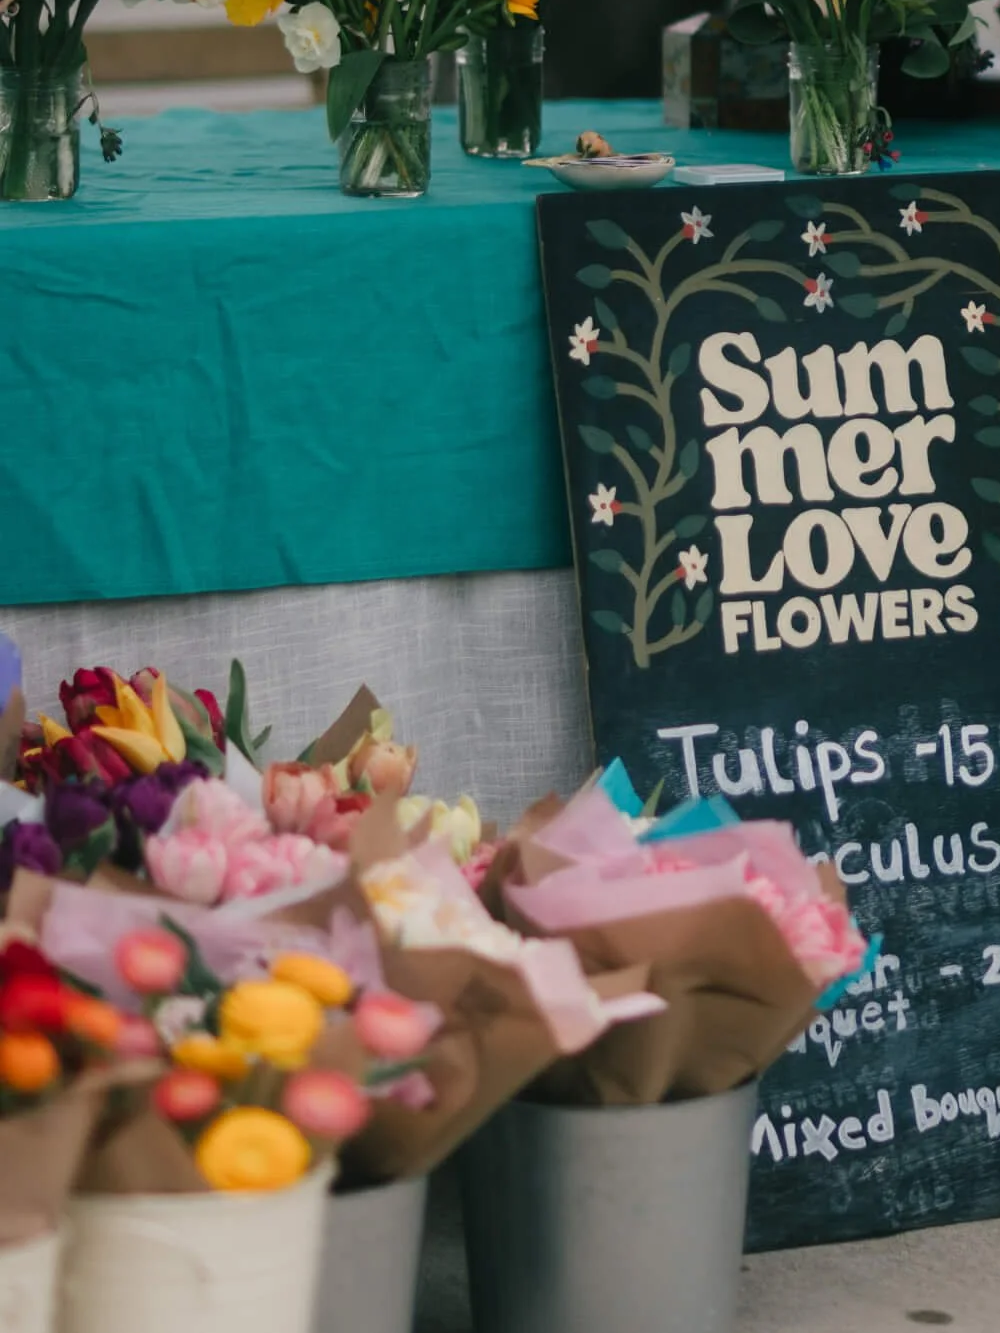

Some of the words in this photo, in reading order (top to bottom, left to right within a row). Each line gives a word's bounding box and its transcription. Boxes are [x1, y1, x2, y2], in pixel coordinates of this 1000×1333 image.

[699, 332, 955, 427] Sum
[705, 414, 956, 510] mer
[721, 585, 979, 654] FLOWERS
[657, 720, 886, 821] Tulips
